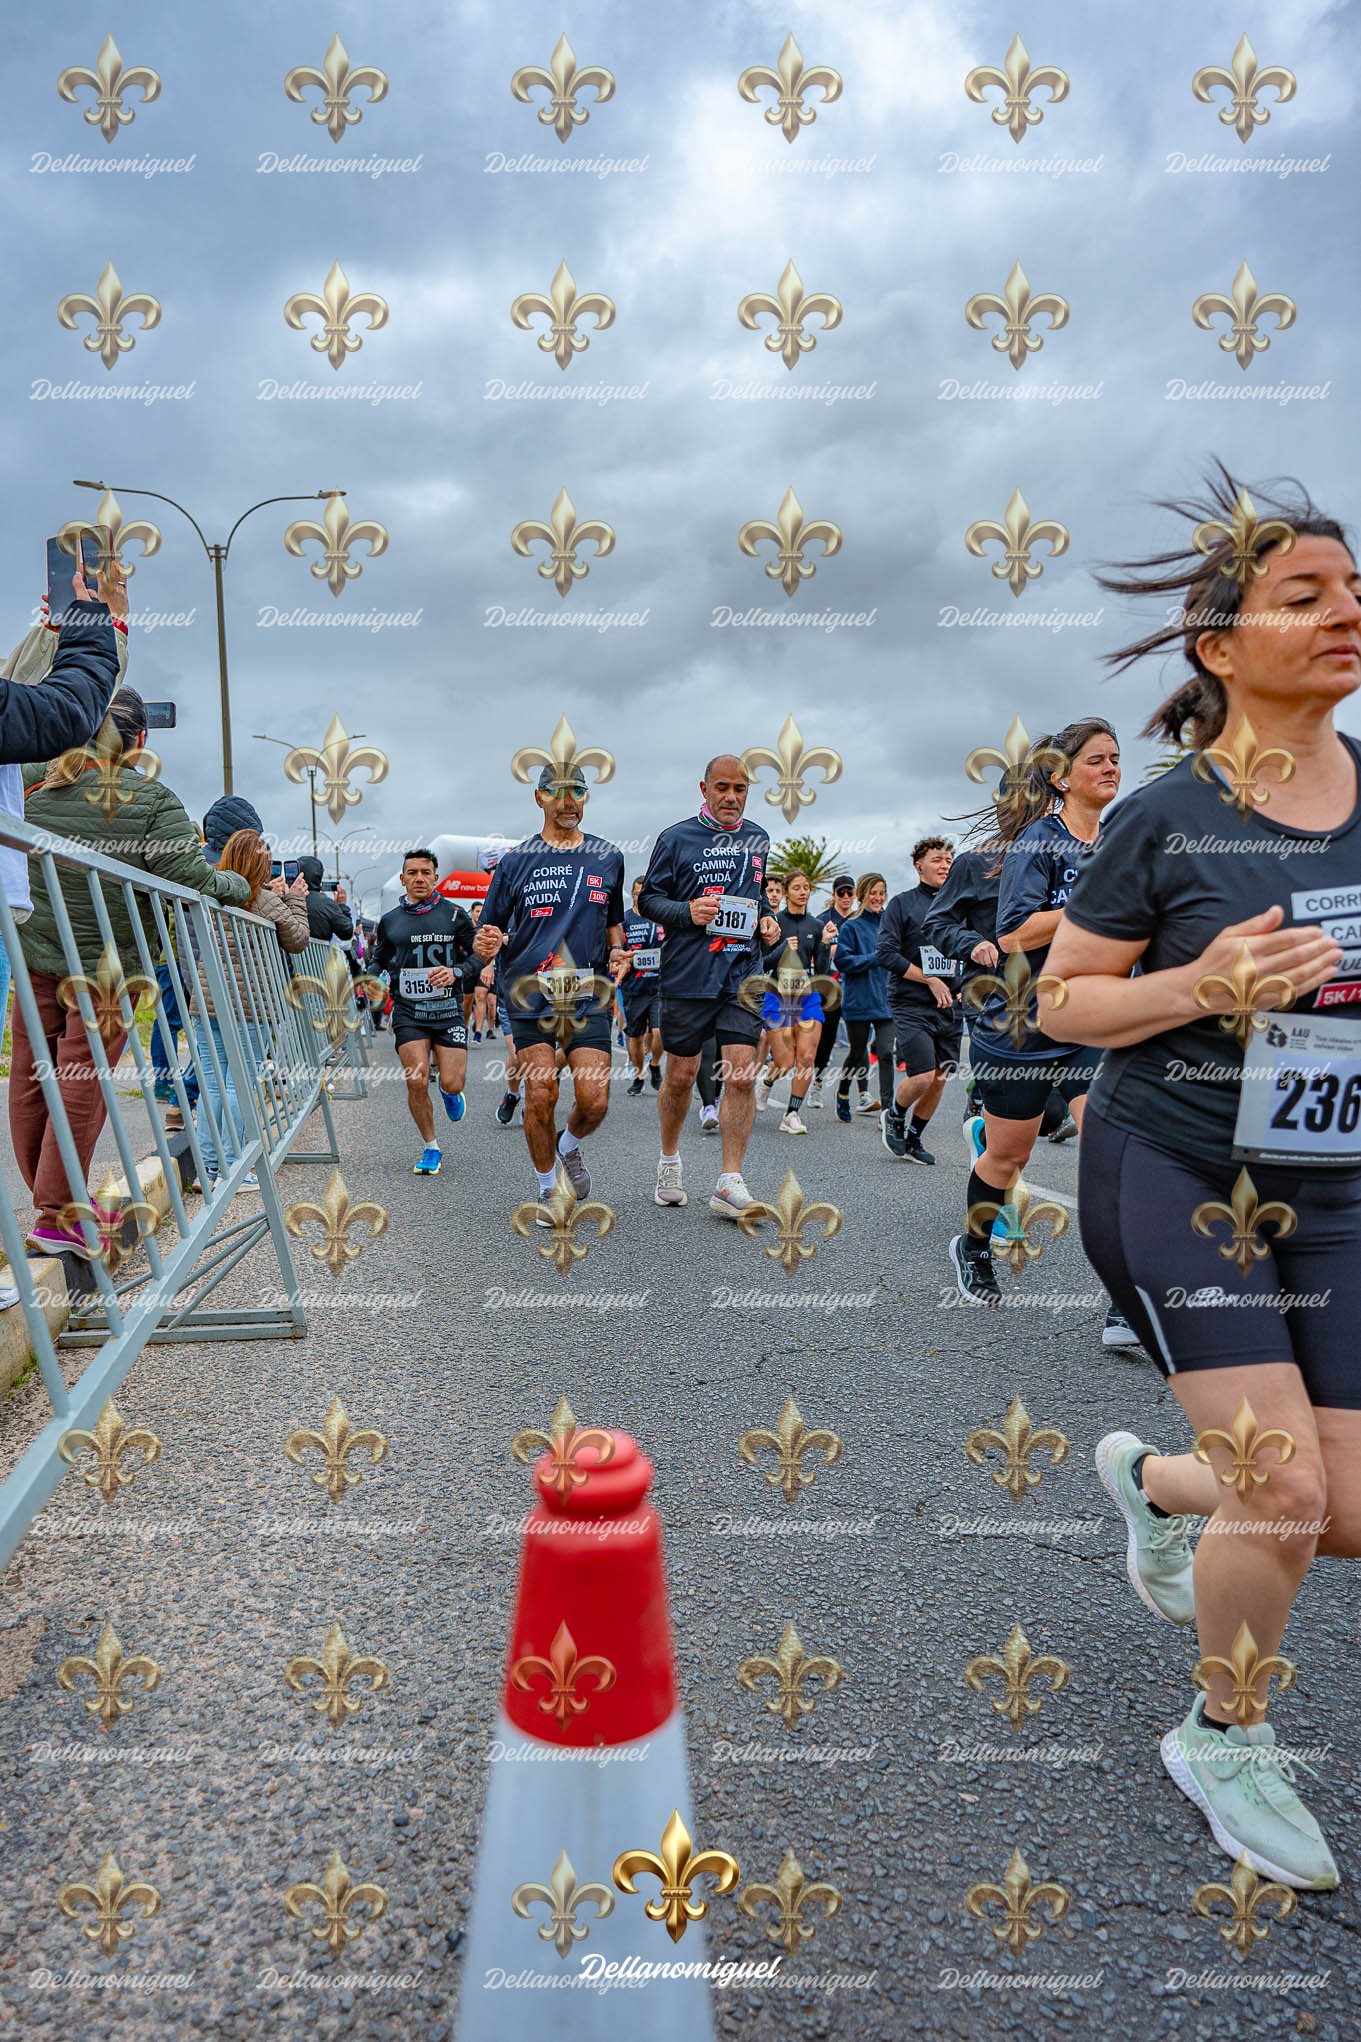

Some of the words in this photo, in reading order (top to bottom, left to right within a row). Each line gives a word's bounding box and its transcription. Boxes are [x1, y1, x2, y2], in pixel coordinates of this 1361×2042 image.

[703, 845, 741, 857] CORRÉ
[533, 864, 573, 878] CORRÉ
[693, 858, 737, 872] CAMINÁ
[589, 878, 600, 886] 5K
[697, 871, 732, 885] AYUDÁ
[524, 891, 561, 907] AYUDÁ
[1050, 888, 1073, 904] CA
[1305, 892, 1361, 912] CORR
[714, 909, 747, 929] 3187
[410, 935, 422, 943] ONE
[1330, 925, 1361, 941] CA
[637, 957, 656, 967] 3051
[928, 957, 952, 970] 3060
[405, 980, 434, 995] 3153
[452, 1032, 466, 1044] 32
